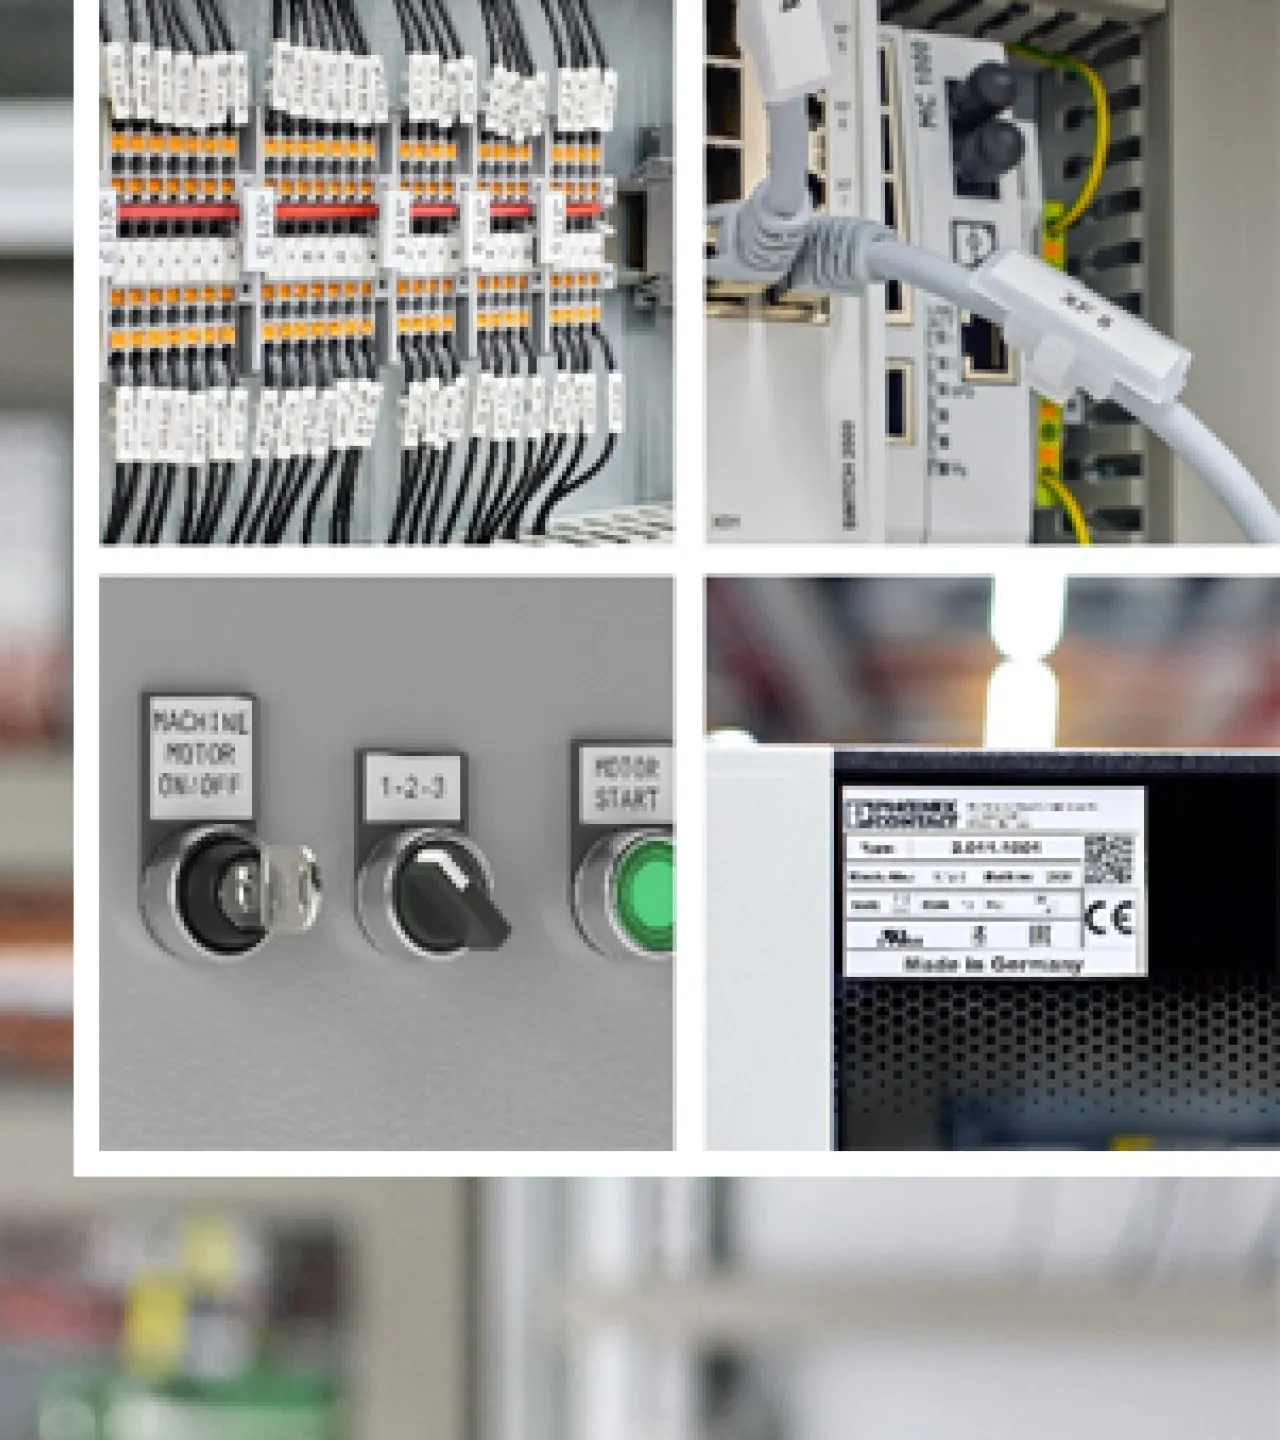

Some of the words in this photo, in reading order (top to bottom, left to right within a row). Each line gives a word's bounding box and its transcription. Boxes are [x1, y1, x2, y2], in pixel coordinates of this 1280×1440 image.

[152, 708, 249, 736] MACHINE
[162, 741, 237, 766] MOTOR
[593, 754, 661, 780] MOTOR
[156, 771, 242, 798] ON/OFF
[592, 785, 661, 812] START
[903, 956, 958, 973] Made
[964, 956, 985, 973] in
[990, 955, 1085, 976] Germany
